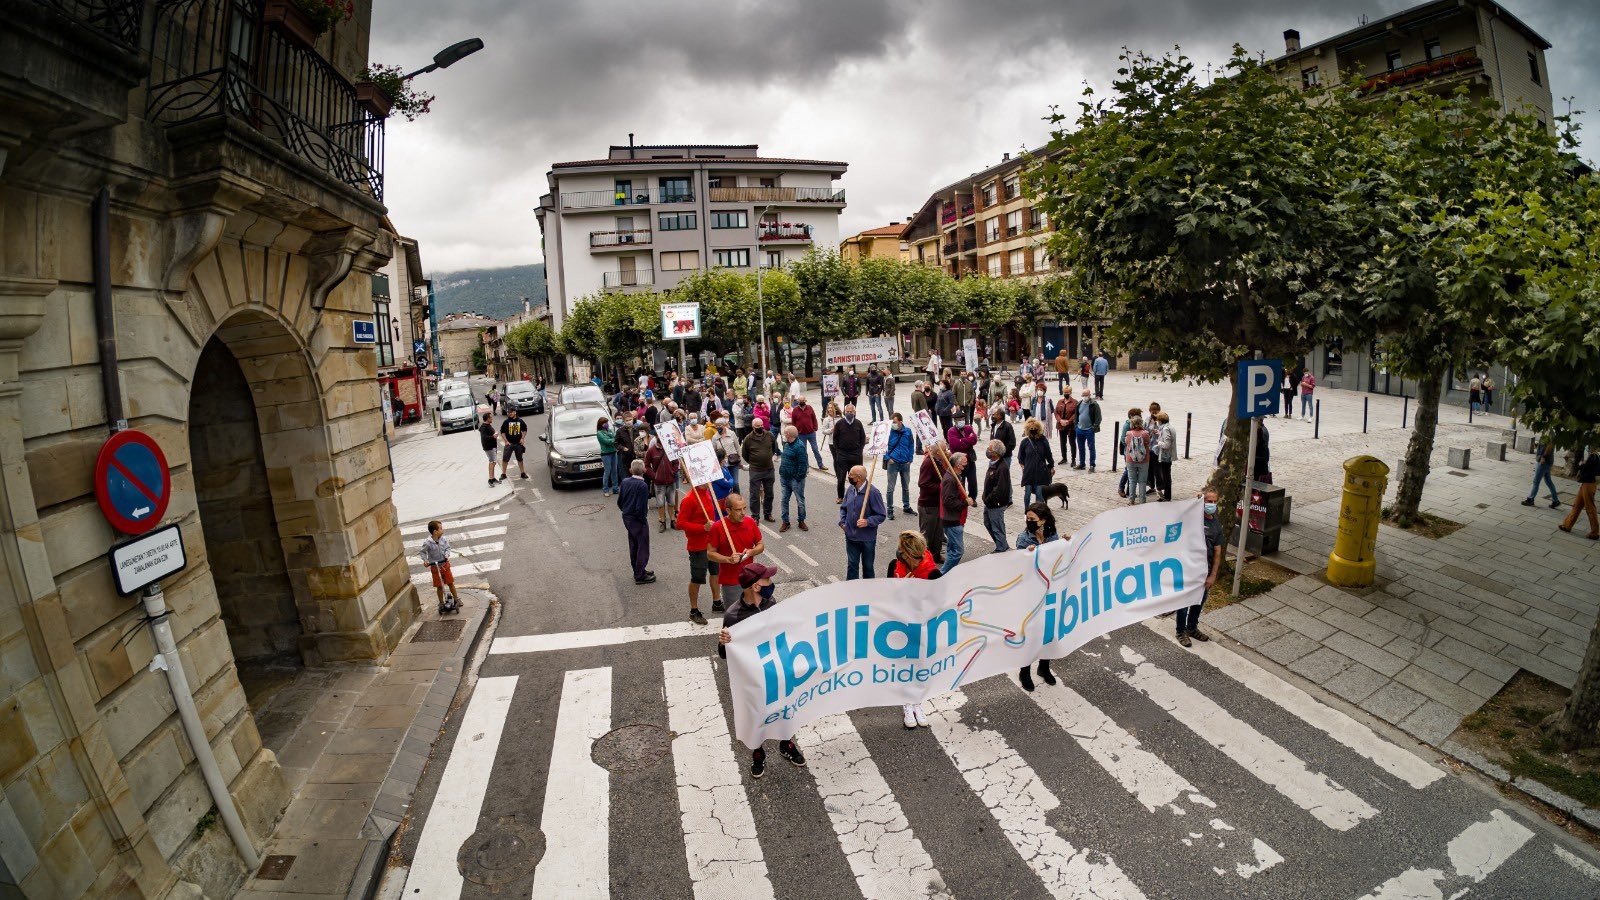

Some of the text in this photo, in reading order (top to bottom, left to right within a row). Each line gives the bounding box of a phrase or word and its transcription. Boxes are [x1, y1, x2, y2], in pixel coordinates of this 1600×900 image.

[833, 355, 860, 363] AMNISTIA
[1247, 365, 1274, 413] P
[1126, 526, 1147, 536] izan
[1126, 534, 1156, 546] bidea
[1043, 557, 1184, 645] ibilian
[757, 605, 958, 705] ibilian
[764, 654, 955, 725] etxerako bidean
